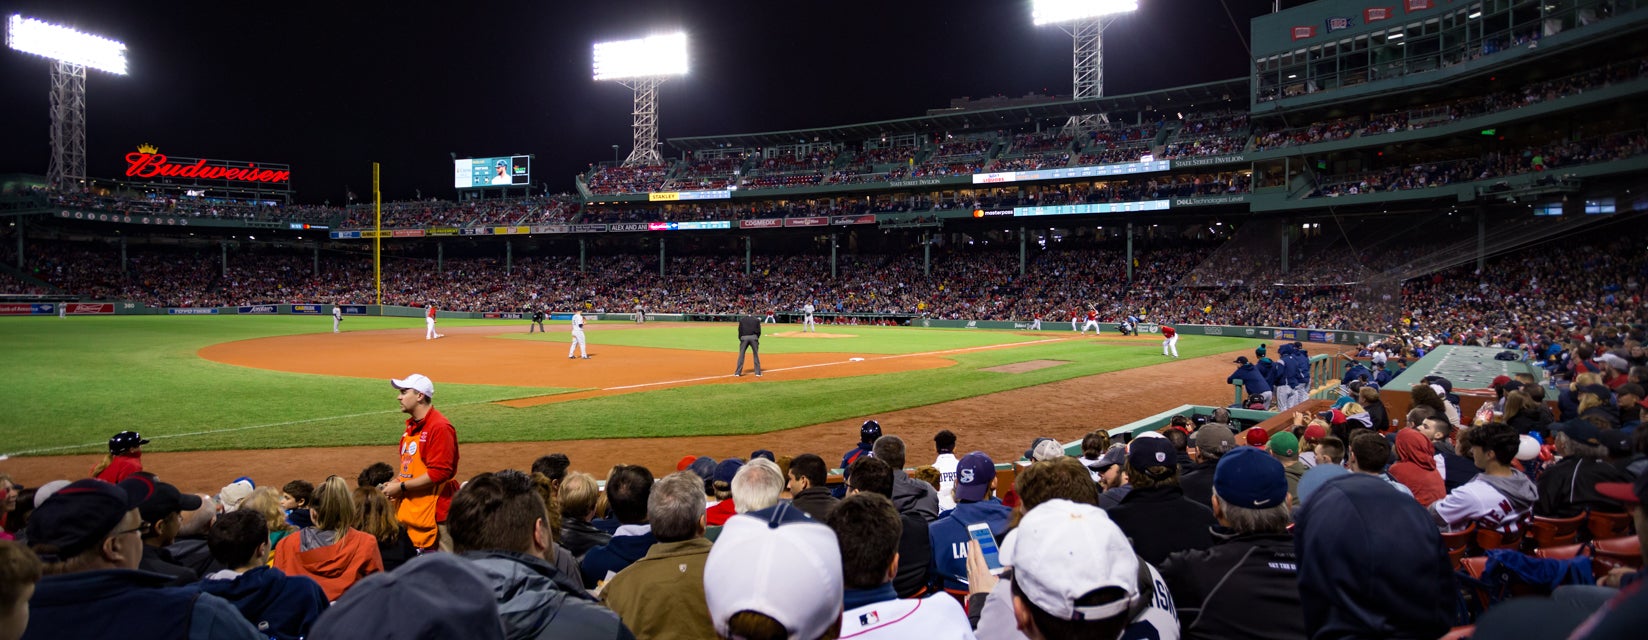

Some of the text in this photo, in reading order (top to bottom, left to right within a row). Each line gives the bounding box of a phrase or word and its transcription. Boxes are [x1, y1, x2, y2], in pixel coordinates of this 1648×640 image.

[125, 152, 290, 183] Budweiser
[744, 219, 776, 227] COGMEDIX
[960, 468, 974, 483] S
